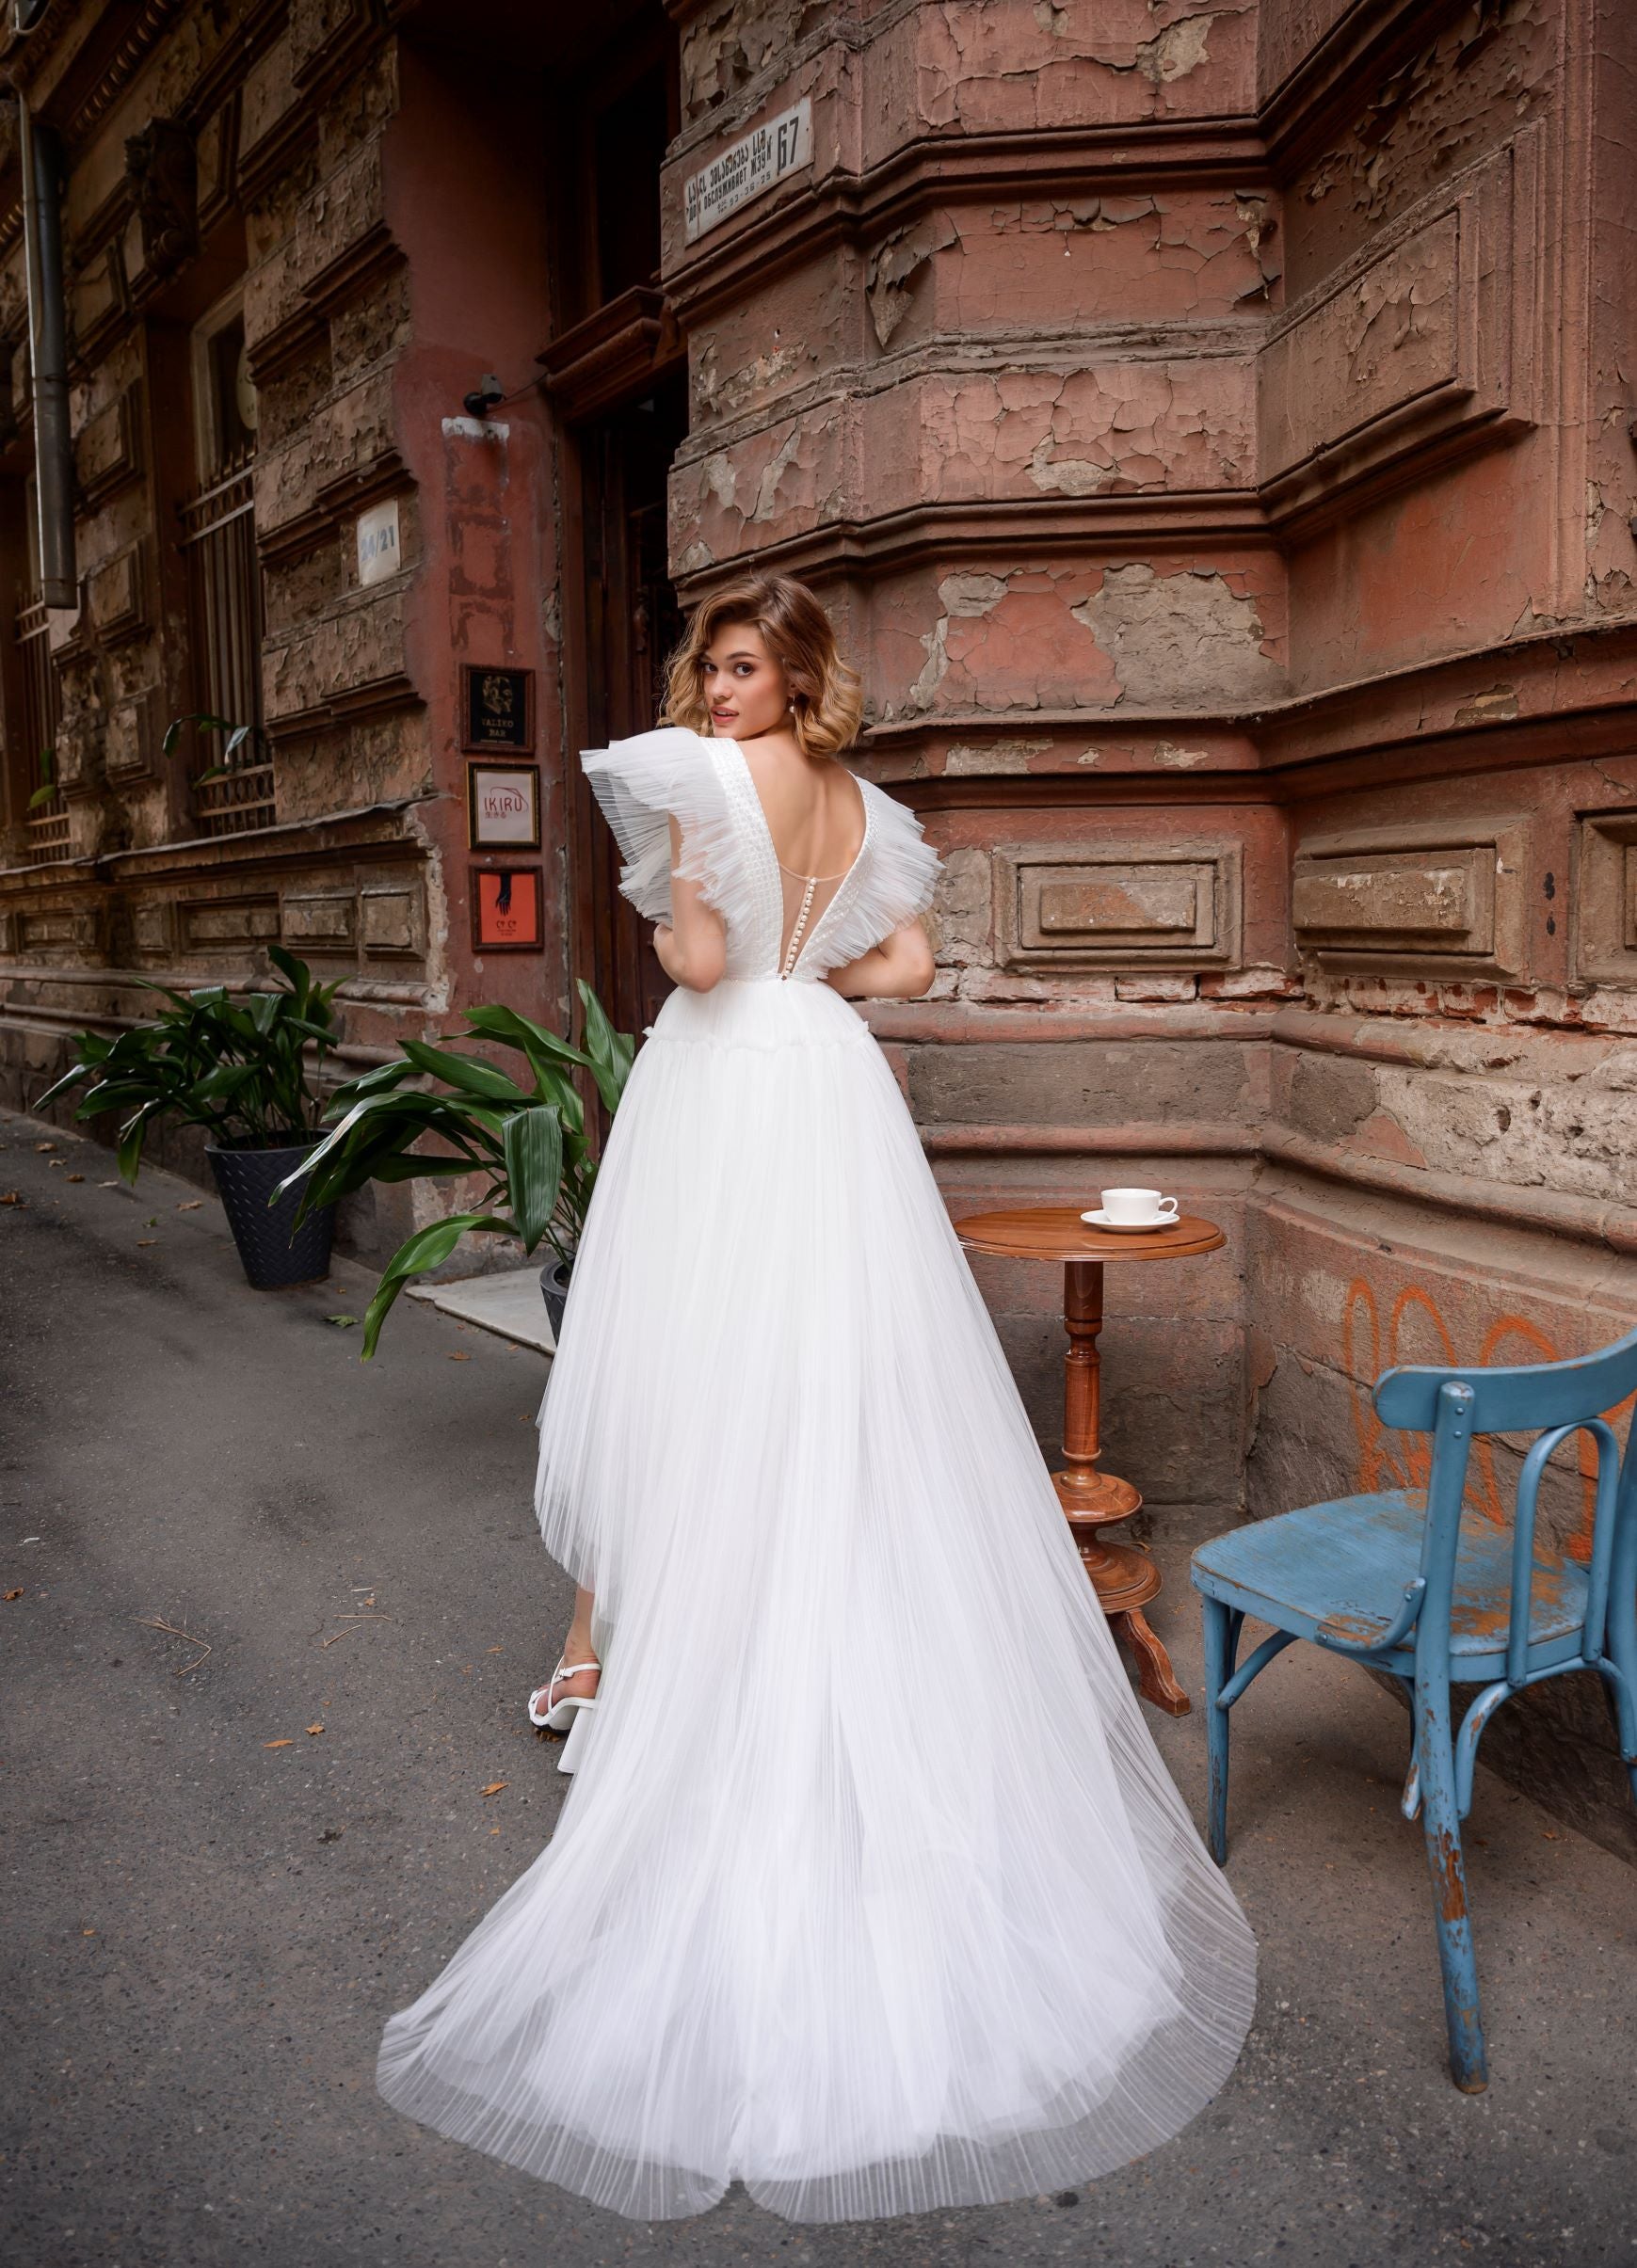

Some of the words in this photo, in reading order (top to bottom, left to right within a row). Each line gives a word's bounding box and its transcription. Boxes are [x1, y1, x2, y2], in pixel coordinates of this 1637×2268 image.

[778, 116, 799, 173] 67
[489, 728, 506, 737] BAR
[484, 797, 522, 812] IKIRU
